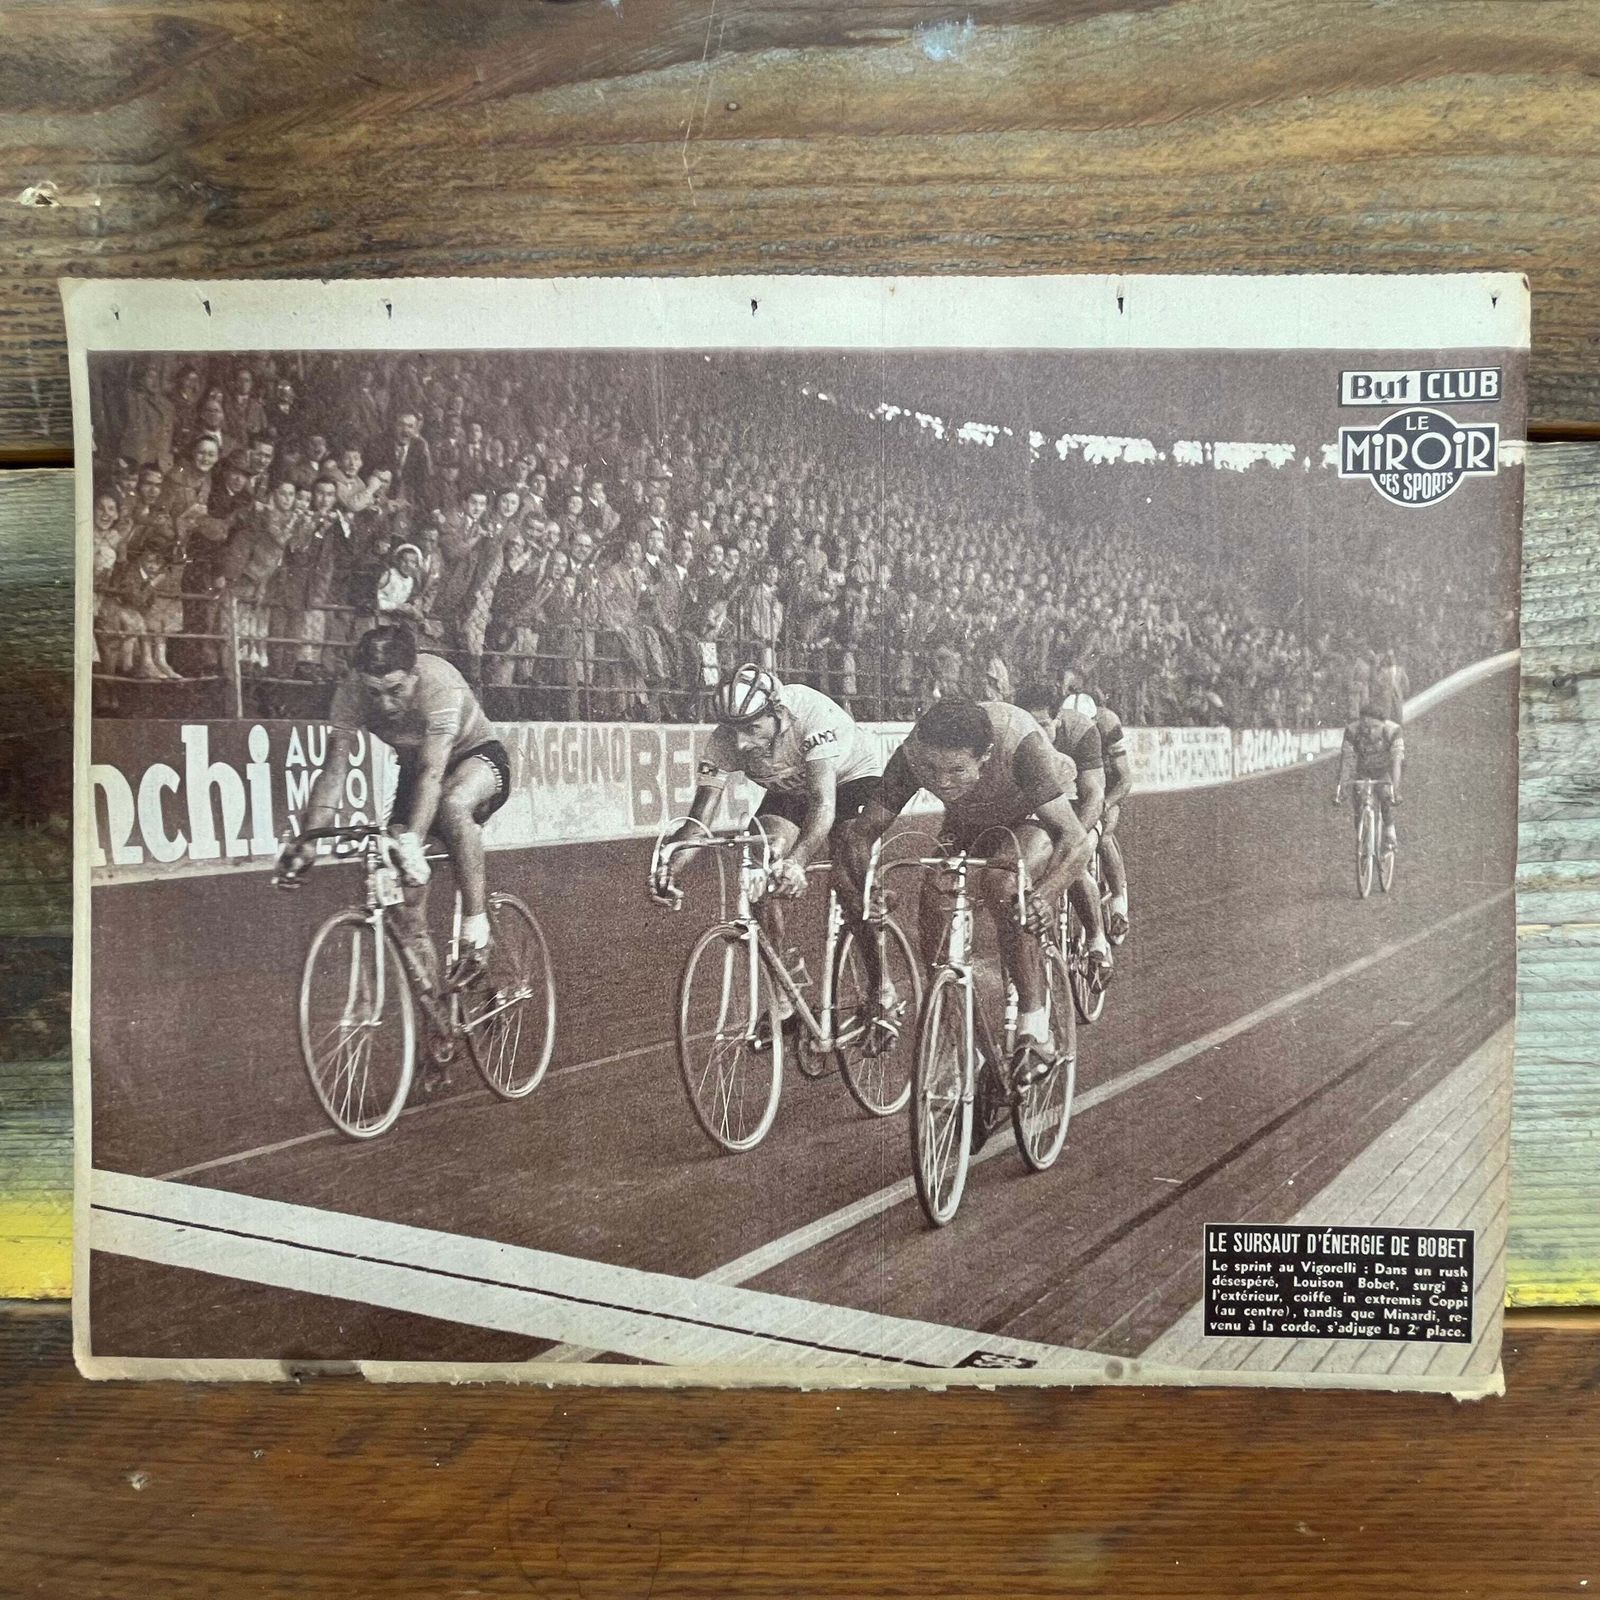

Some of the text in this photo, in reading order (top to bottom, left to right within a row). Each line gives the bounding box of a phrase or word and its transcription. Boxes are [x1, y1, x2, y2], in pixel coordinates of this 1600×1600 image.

[1351, 371, 1498, 399] But CLUB
[1406, 416, 1429, 430] LE
[1379, 472, 1453, 501] DES SPORTS
[285, 725, 366, 767] AUO
[1210, 1227, 1466, 1258] LE SURSAUT D'ÉNERGIE DE BOBET
[1213, 1260, 1228, 1271] Le
[1235, 1261, 1272, 1274] sprint
[1279, 1264, 1294, 1272] au
[1301, 1261, 1356, 1275] Vigorelli
[1375, 1263, 1407, 1275] Dans
[1415, 1268, 1431, 1276] un
[1440, 1266, 1467, 1277] rush
[1212, 1275, 1468, 1294] désespéré, Louison Bobet, surgi à
[1213, 1288, 1468, 1309] l'extérieur, coiffe in extremis Coppi
[1215, 1305, 1235, 1315] (au
[1244, 1306, 1296, 1318] centre),
[1304, 1306, 1342, 1318] tandis
[1351, 1311, 1375, 1321] que
[1384, 1308, 1440, 1322] Minardi,
[1248, 1320, 1255, 1330] à
[1263, 1320, 1273, 1331] la
[1281, 1321, 1320, 1333] corde,
[1328, 1322, 1381, 1336] s'adjuge
[1389, 1324, 1399, 1334] la
[1427, 1325, 1465, 1338] place.
